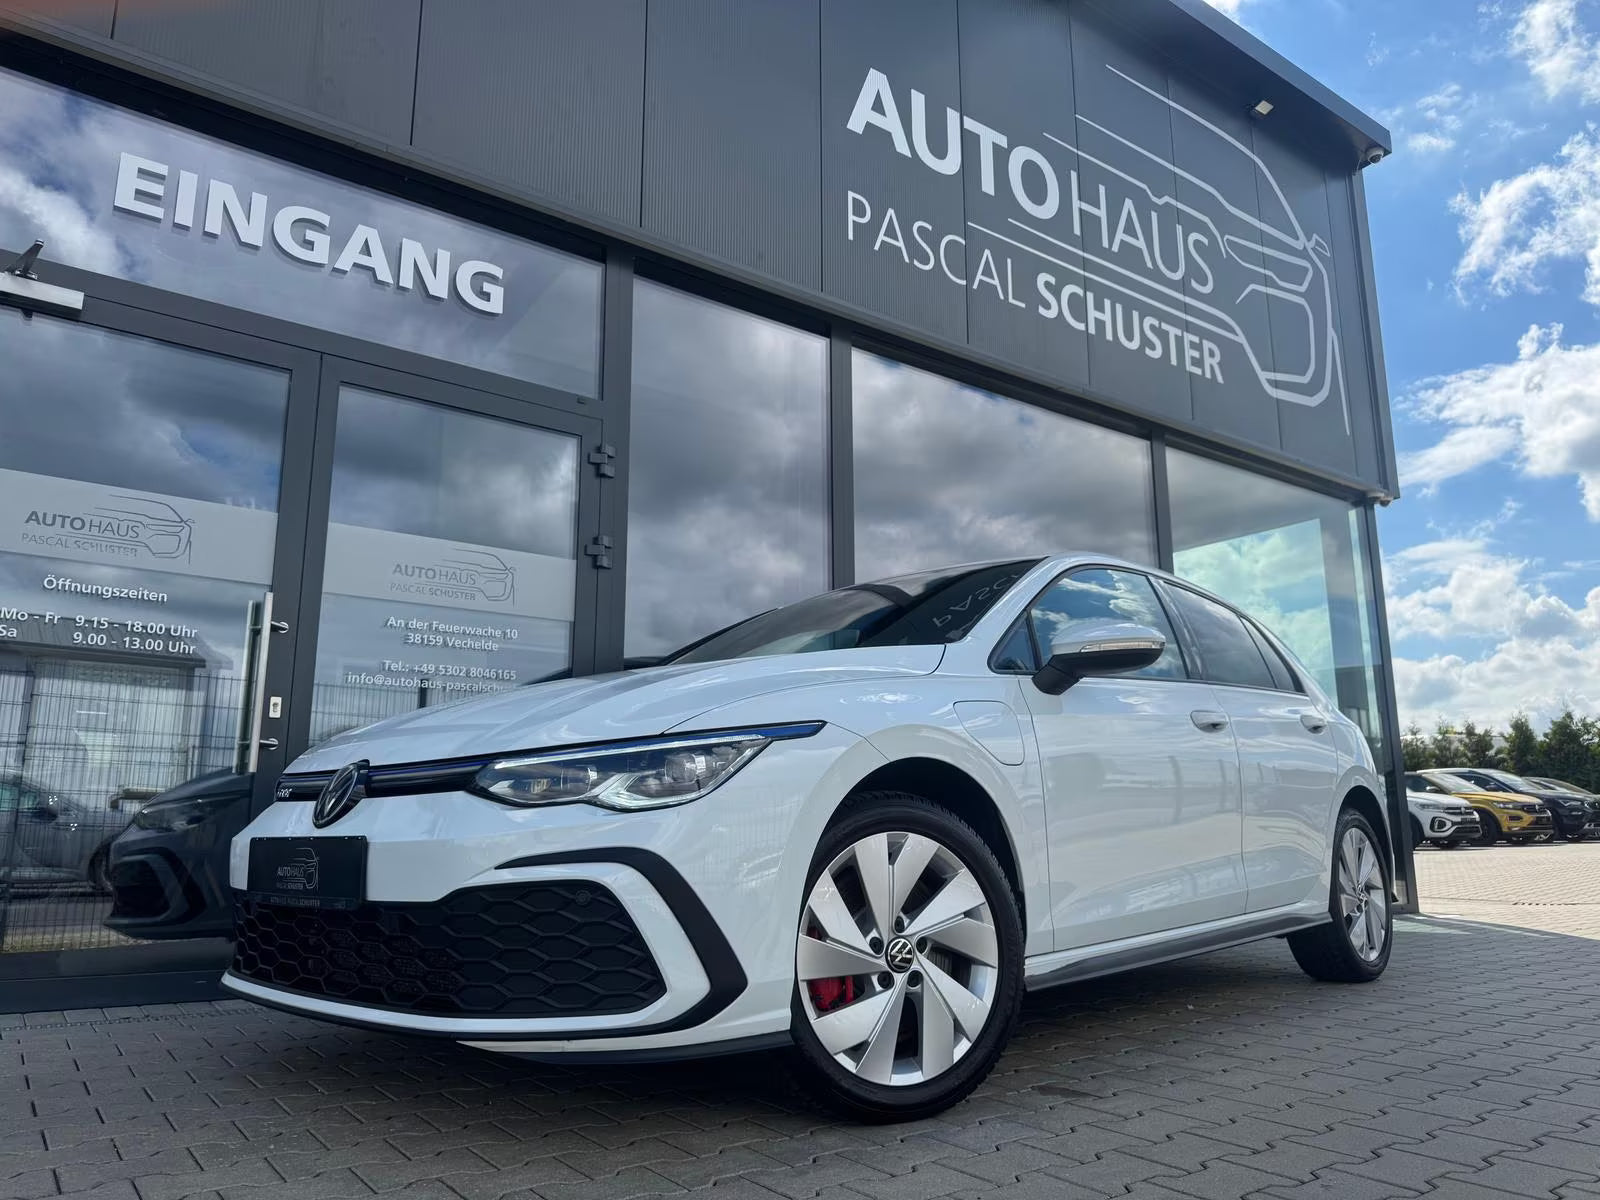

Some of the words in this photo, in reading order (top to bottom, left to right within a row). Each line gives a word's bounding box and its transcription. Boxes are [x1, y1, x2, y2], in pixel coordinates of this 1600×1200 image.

[114, 152, 504, 315] EINGANG
[847, 190, 1025, 307] PASCAL
[1036, 272, 1225, 384] SCHUSTER
[21, 532, 71, 549] PASCAL
[74, 540, 138, 557] SCHUSTER
[43, 574, 168, 603] Öffnungszeiten
[390, 583, 426, 594] PASCAL
[428, 587, 477, 601] SCHUSTER
[0, 607, 28, 621] Mo
[45, 611, 61, 624] Fr
[75, 615, 109, 630] 9.15
[125, 620, 166, 635] 18.00
[170, 624, 198, 638] Uhr
[387, 616, 405, 628] An
[408, 618, 429, 630] der
[432, 621, 502, 638] Feuerwache
[506, 628, 518, 639] 10
[73, 632, 107, 646] 9.00
[123, 637, 164, 651] 13.00
[168, 641, 197, 655] Uhr
[407, 633, 443, 646] 38159
[446, 636, 499, 651] Vechelde
[413, 663, 435, 674] +49
[439, 664, 466, 677] 5302
[470, 666, 517, 681] 8046165
